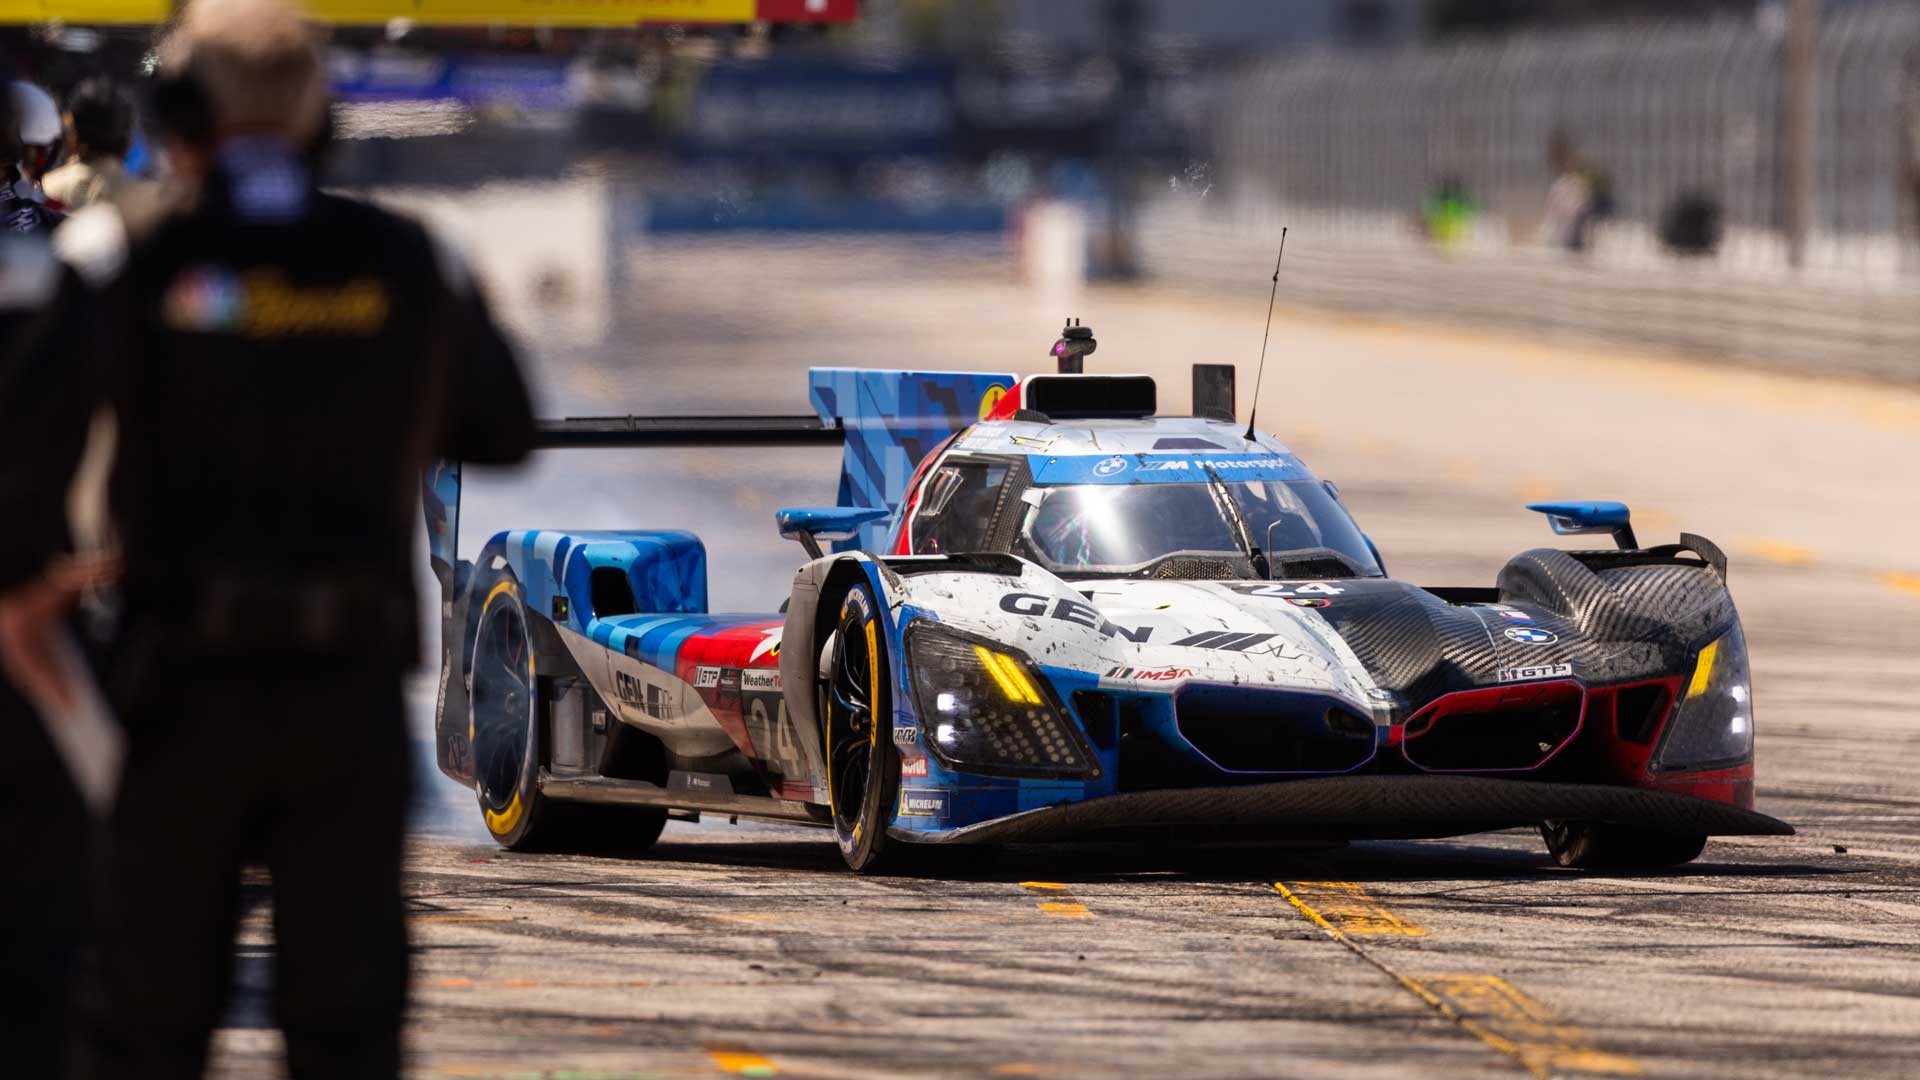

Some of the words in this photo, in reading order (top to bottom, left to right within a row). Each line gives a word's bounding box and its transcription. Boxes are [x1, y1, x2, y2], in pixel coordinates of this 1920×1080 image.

[1240, 583, 1345, 596] 24
[1000, 592, 1154, 643] GEN
[701, 670, 718, 684] GTP
[1133, 668, 1194, 681] IMSA
[1521, 664, 1567, 677] GTP
[751, 698, 799, 778] 24
[909, 799, 943, 810] MICHELIN
